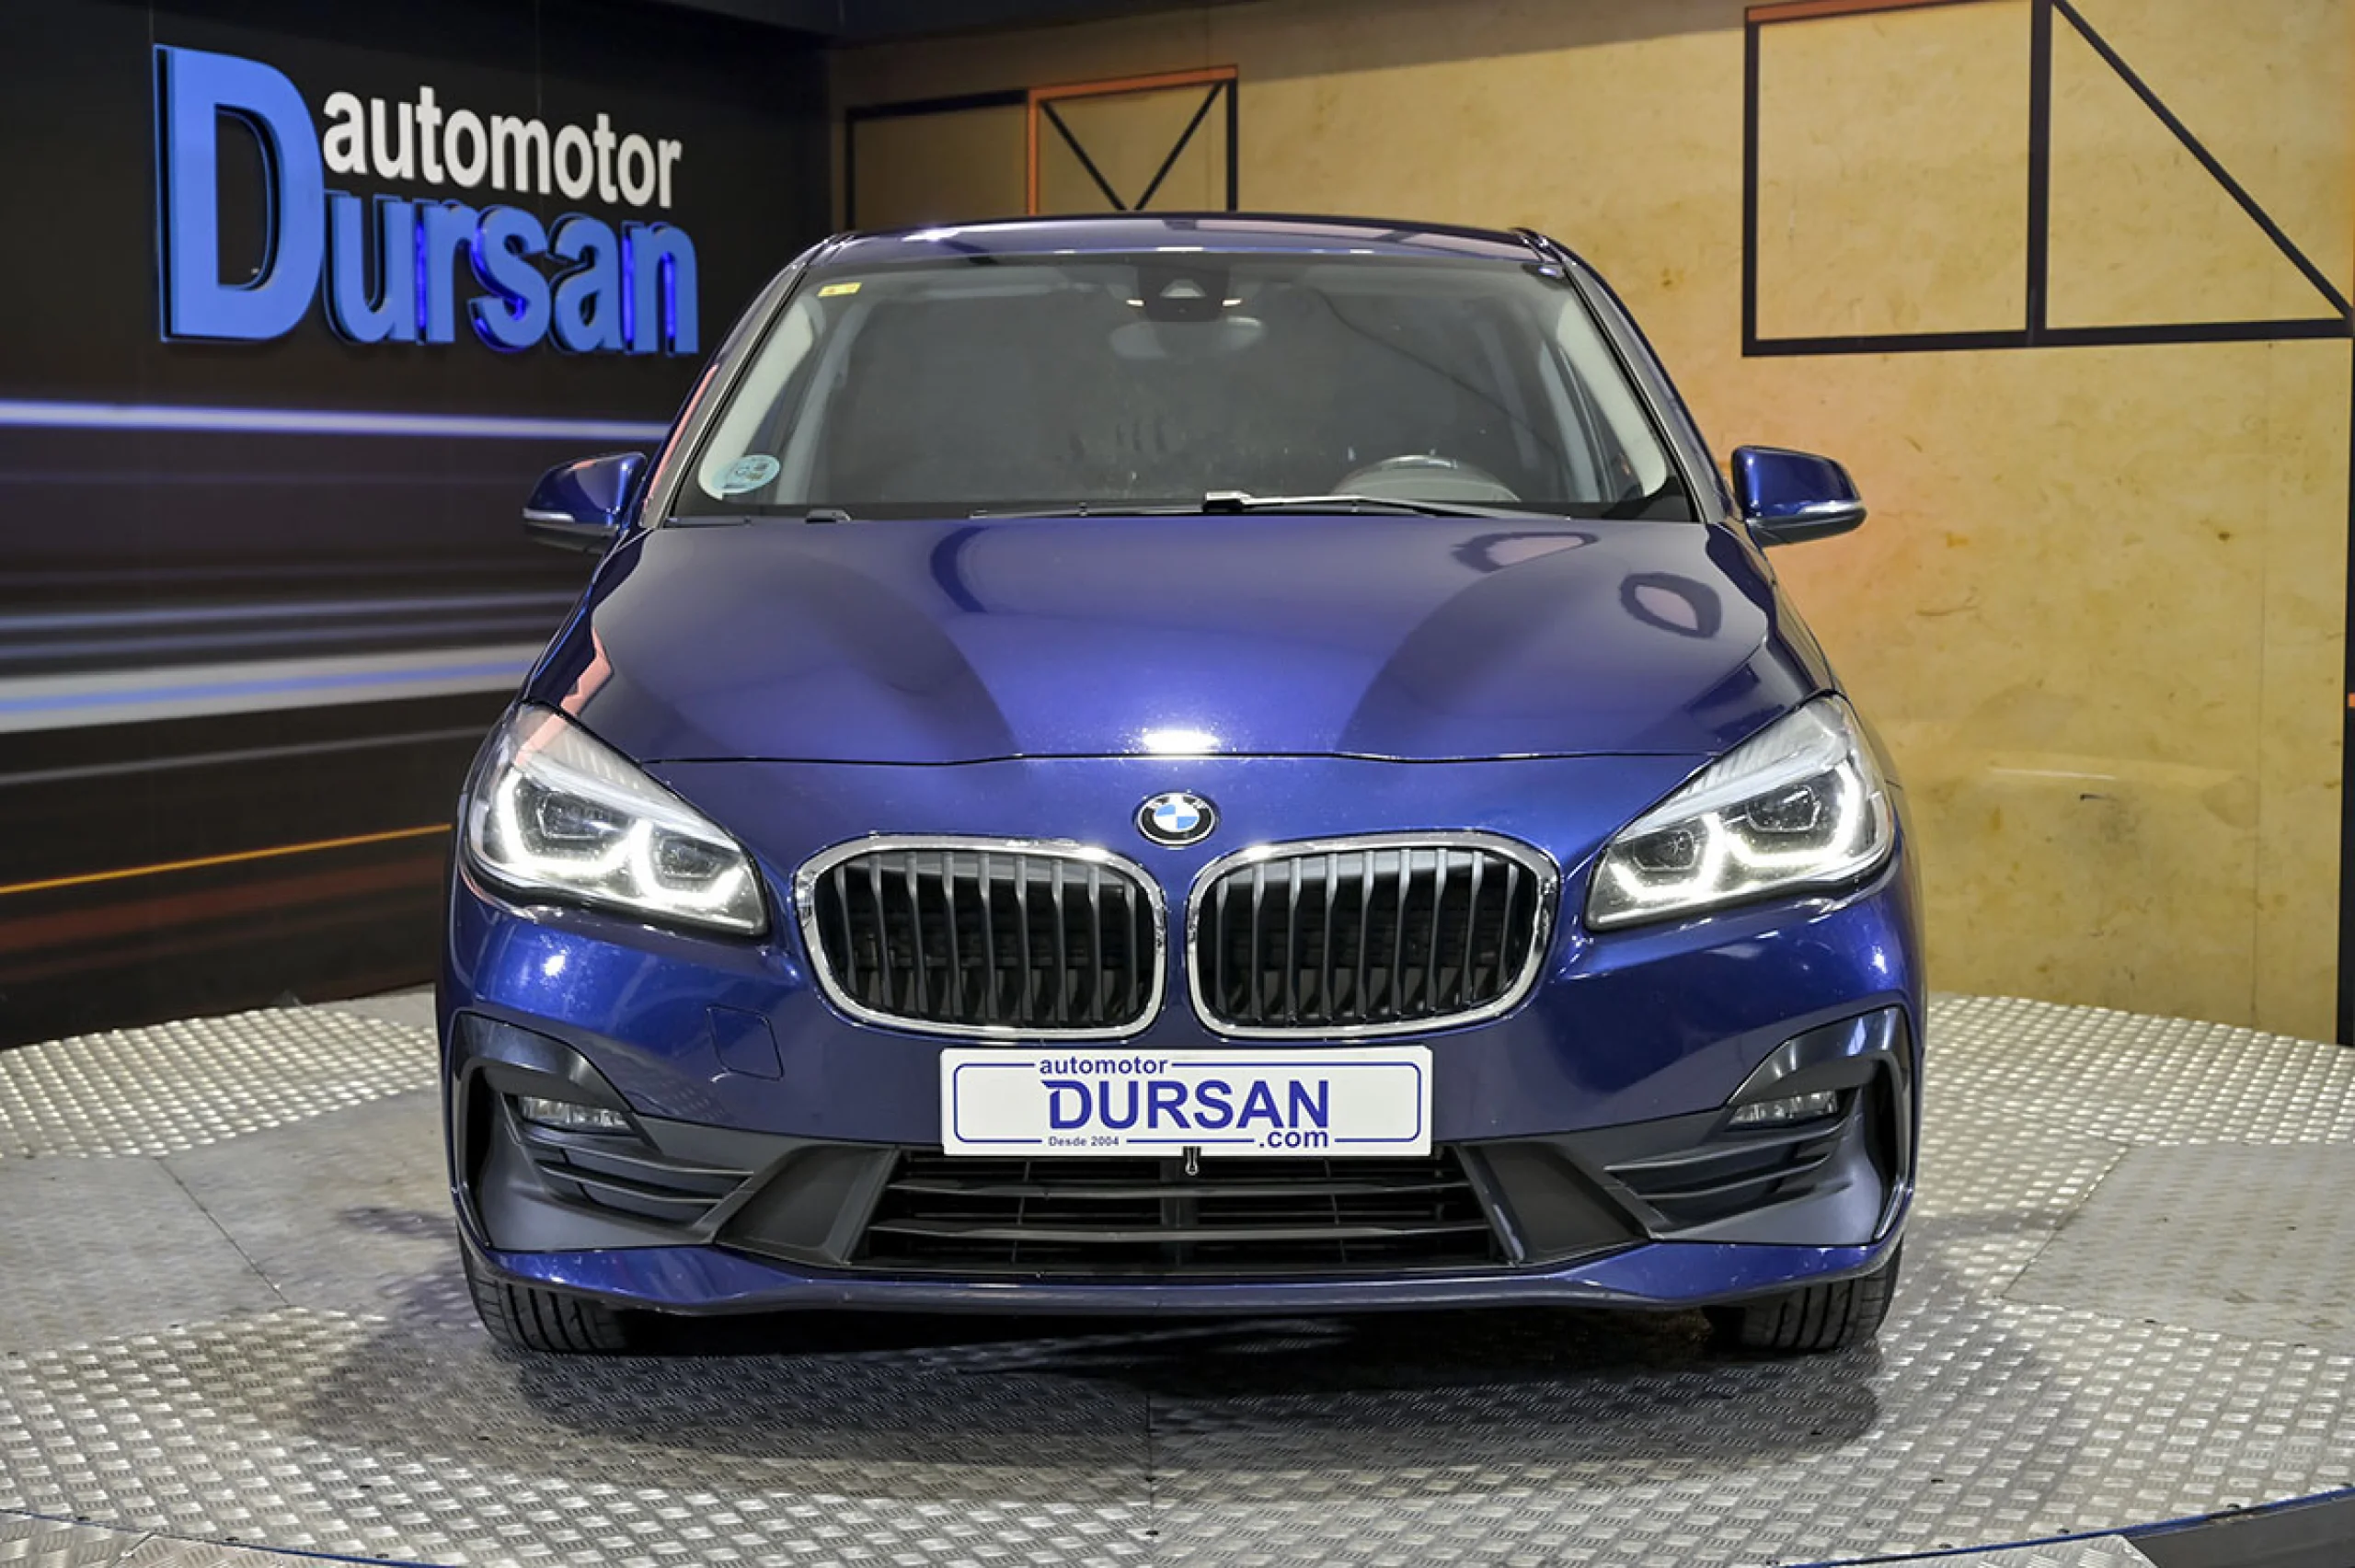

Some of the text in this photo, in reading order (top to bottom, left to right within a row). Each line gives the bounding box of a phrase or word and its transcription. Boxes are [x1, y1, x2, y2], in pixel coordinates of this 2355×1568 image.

[323, 86, 683, 208] automotor
[153, 43, 700, 355] Dursan
[1040, 1056, 1168, 1074] automotor
[1040, 1079, 1329, 1130] DURSAN
[1048, 1136, 1120, 1147] Desde 2004
[1258, 1129, 1329, 1149] .com
